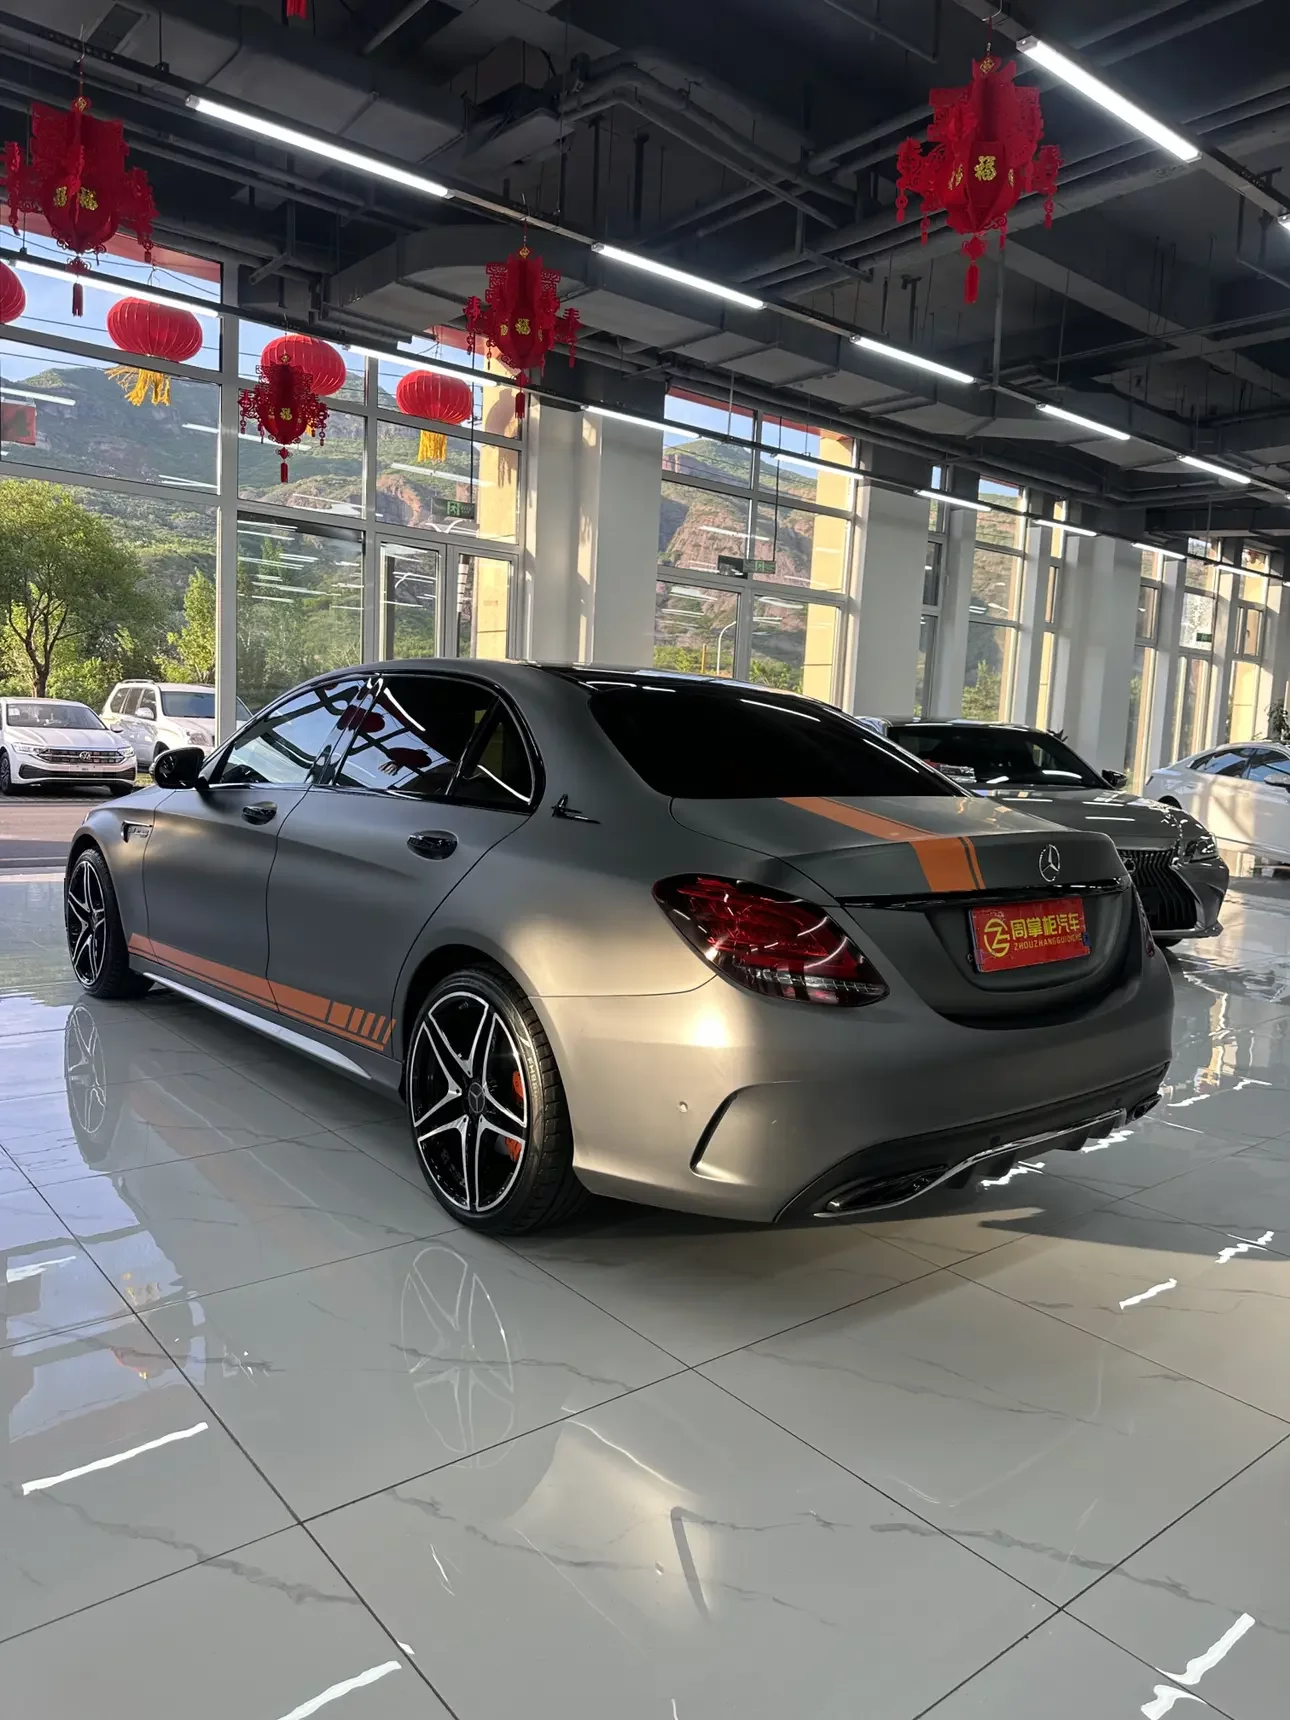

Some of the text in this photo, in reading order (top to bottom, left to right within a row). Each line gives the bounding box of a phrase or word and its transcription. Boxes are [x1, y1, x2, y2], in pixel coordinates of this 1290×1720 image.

[973, 155, 997, 182] 福
[1010, 913, 1080, 941] 周掌柜汽车
